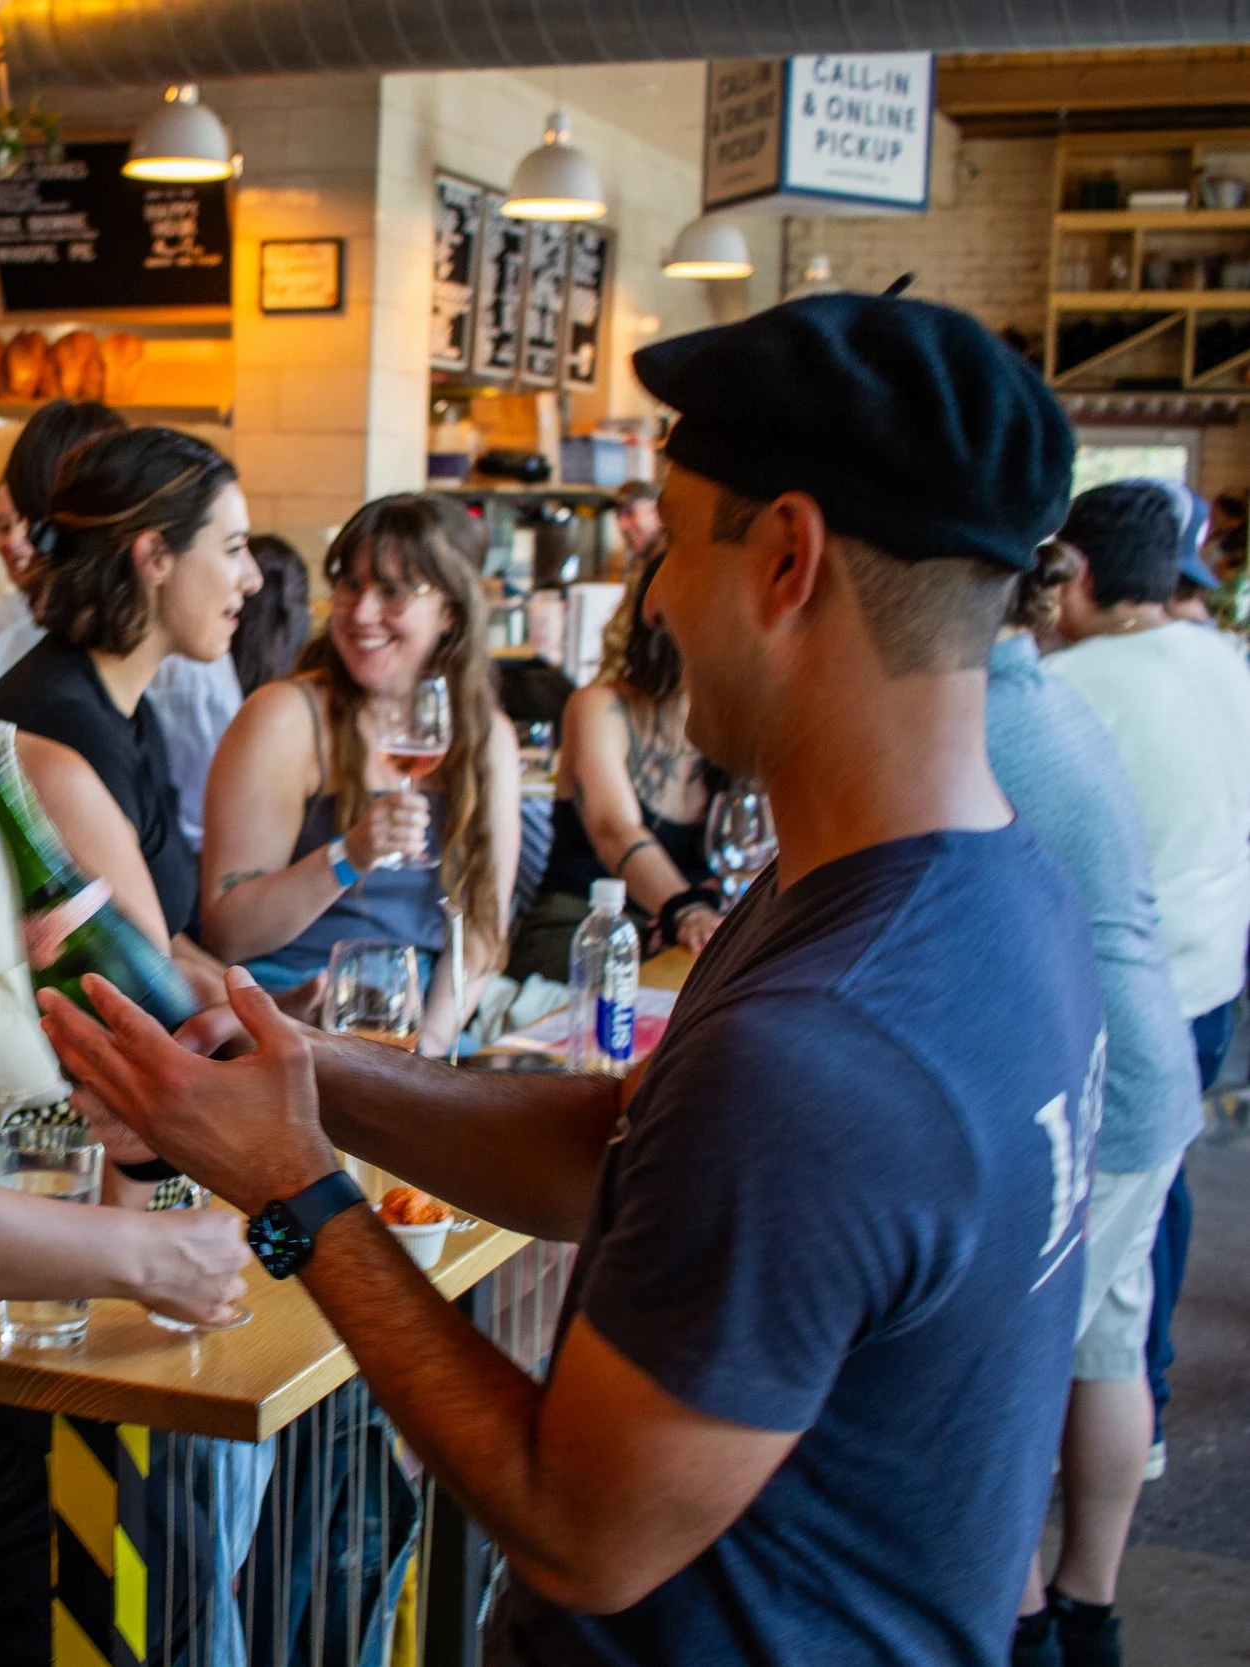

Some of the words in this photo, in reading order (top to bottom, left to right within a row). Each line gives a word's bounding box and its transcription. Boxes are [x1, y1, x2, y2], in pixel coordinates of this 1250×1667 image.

[813, 54, 910, 96] CALL-IN
[802, 90, 816, 118] &
[826, 94, 918, 133] ONLINE
[814, 128, 902, 165] PICKUP
